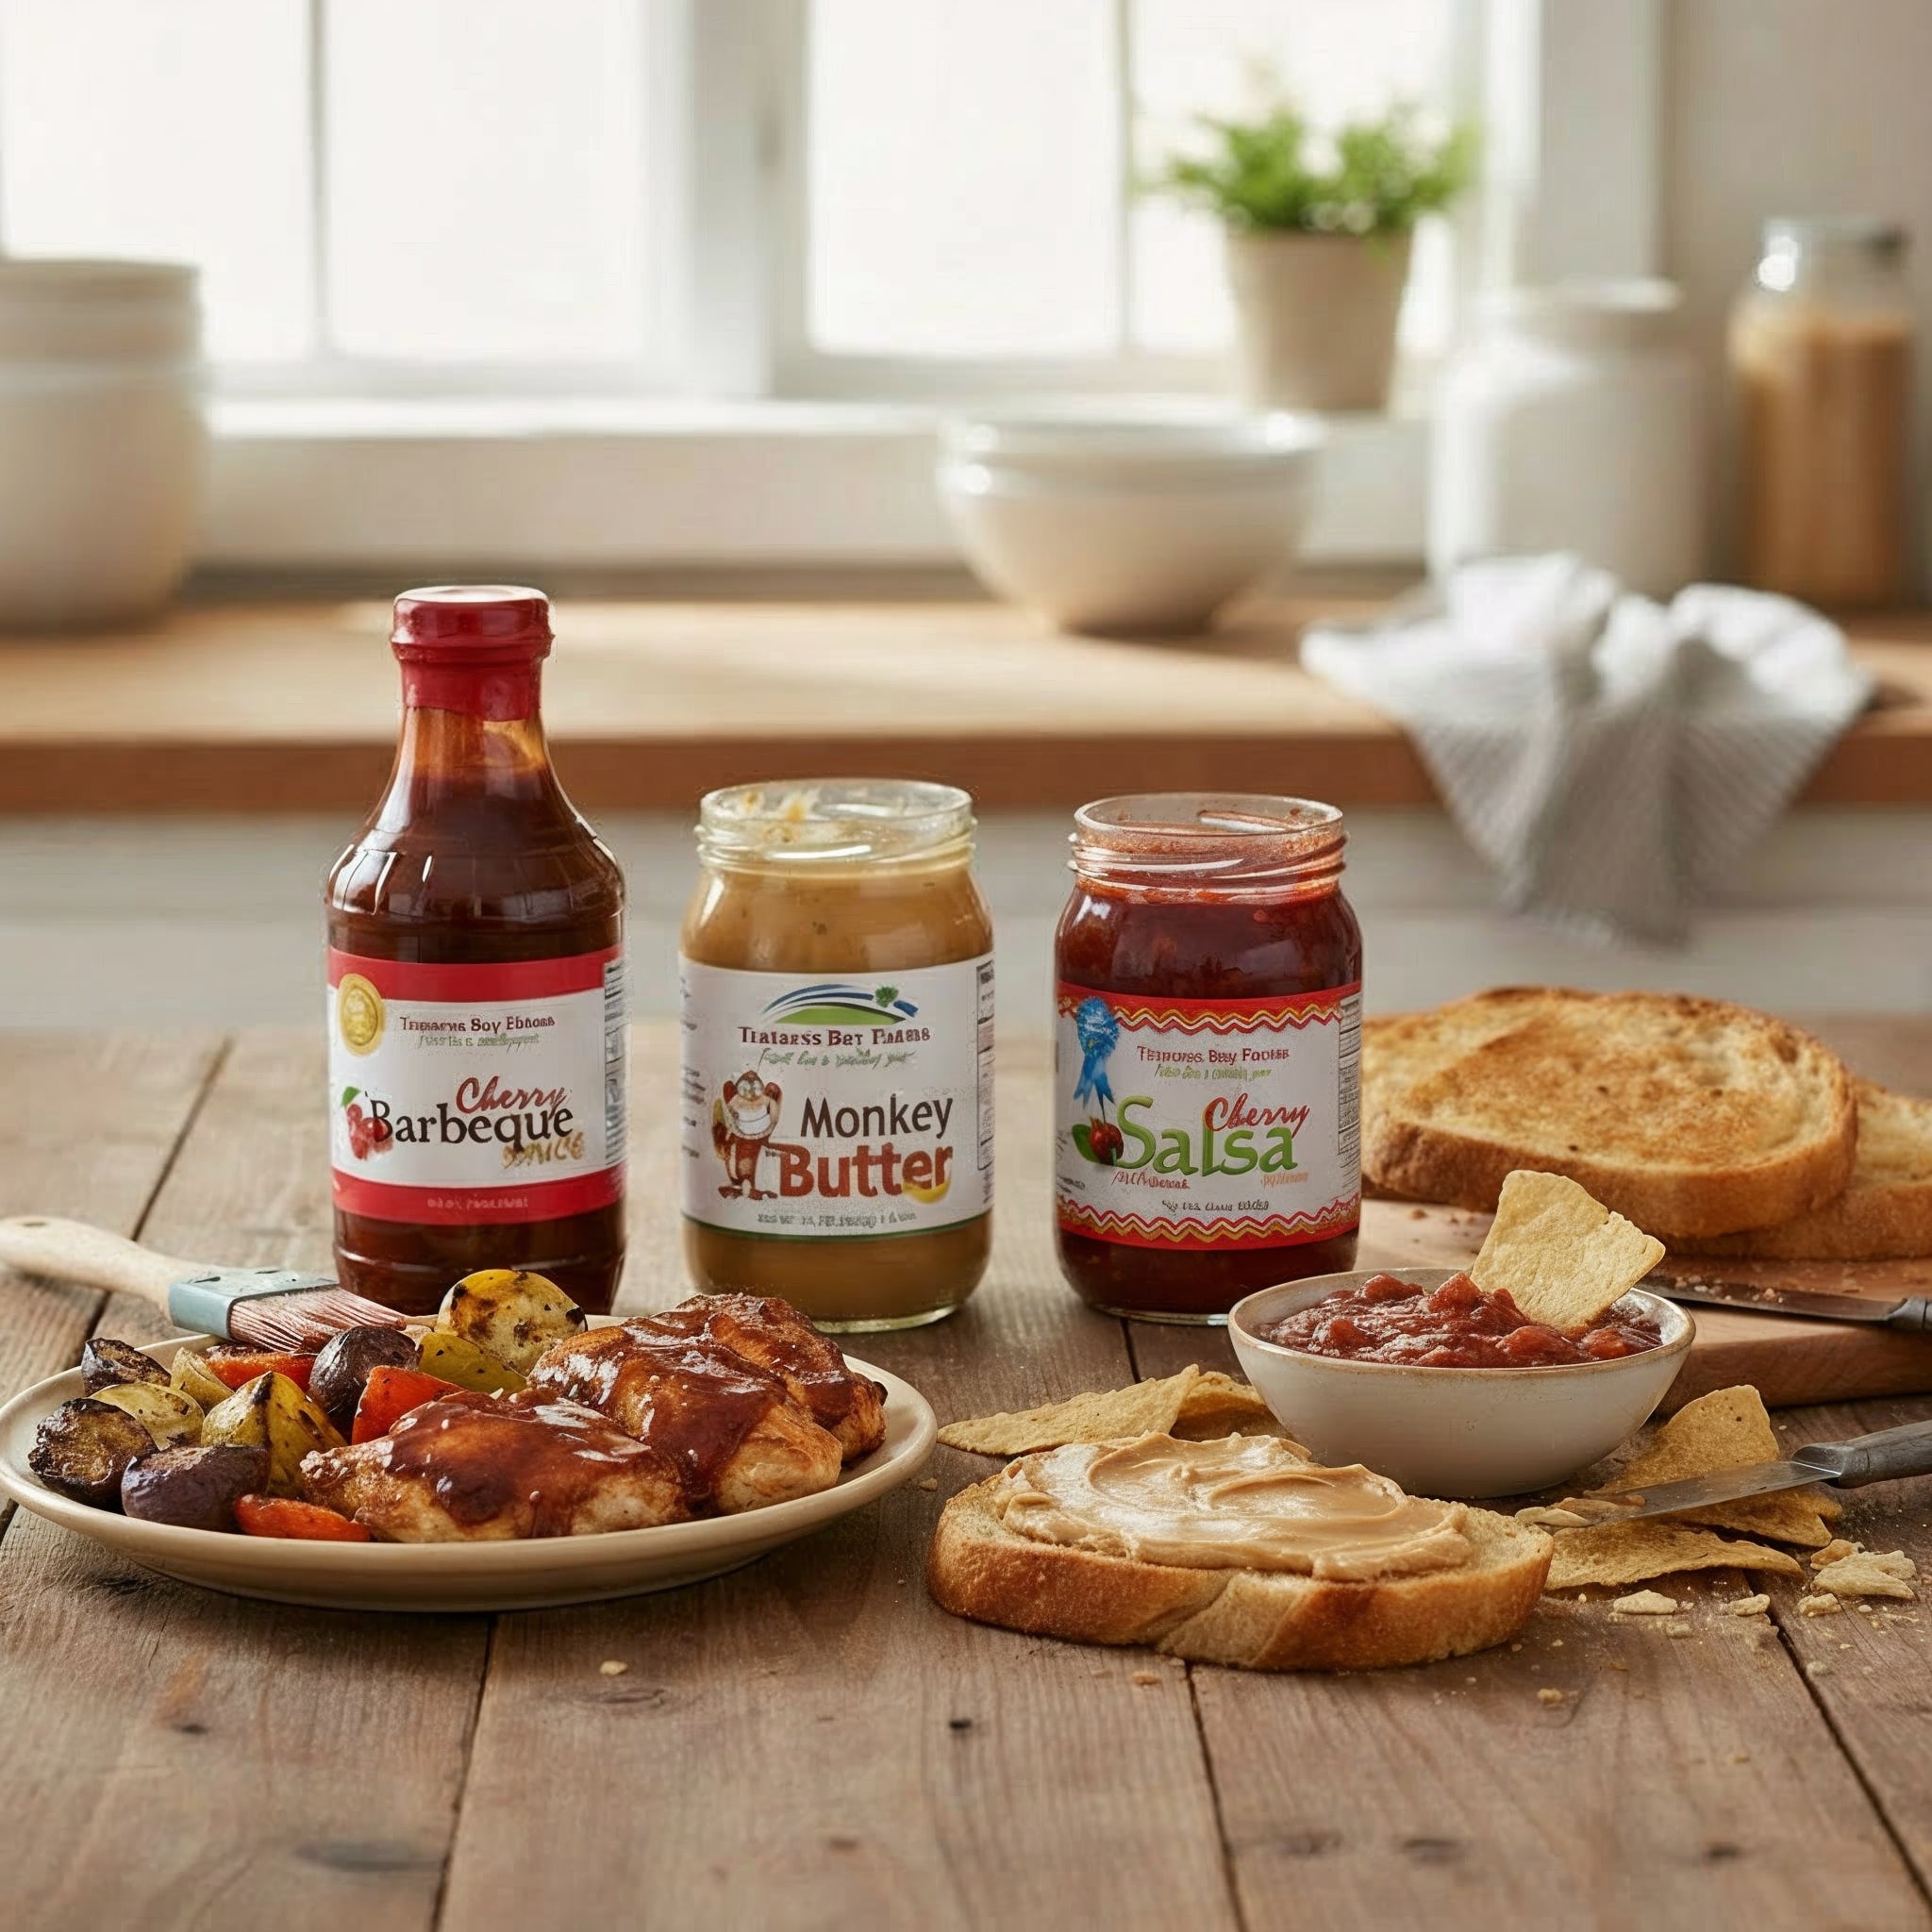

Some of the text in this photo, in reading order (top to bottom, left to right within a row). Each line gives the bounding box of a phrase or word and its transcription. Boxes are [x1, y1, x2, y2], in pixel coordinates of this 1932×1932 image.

[456, 1075, 566, 1119] Cherry
[800, 1093, 954, 1139] Monkey
[1202, 1092, 1310, 1138] Cherry
[371, 1099, 574, 1153] Barbeque
[1115, 1094, 1299, 1177] Salsa
[775, 1141, 954, 1199] Butter
